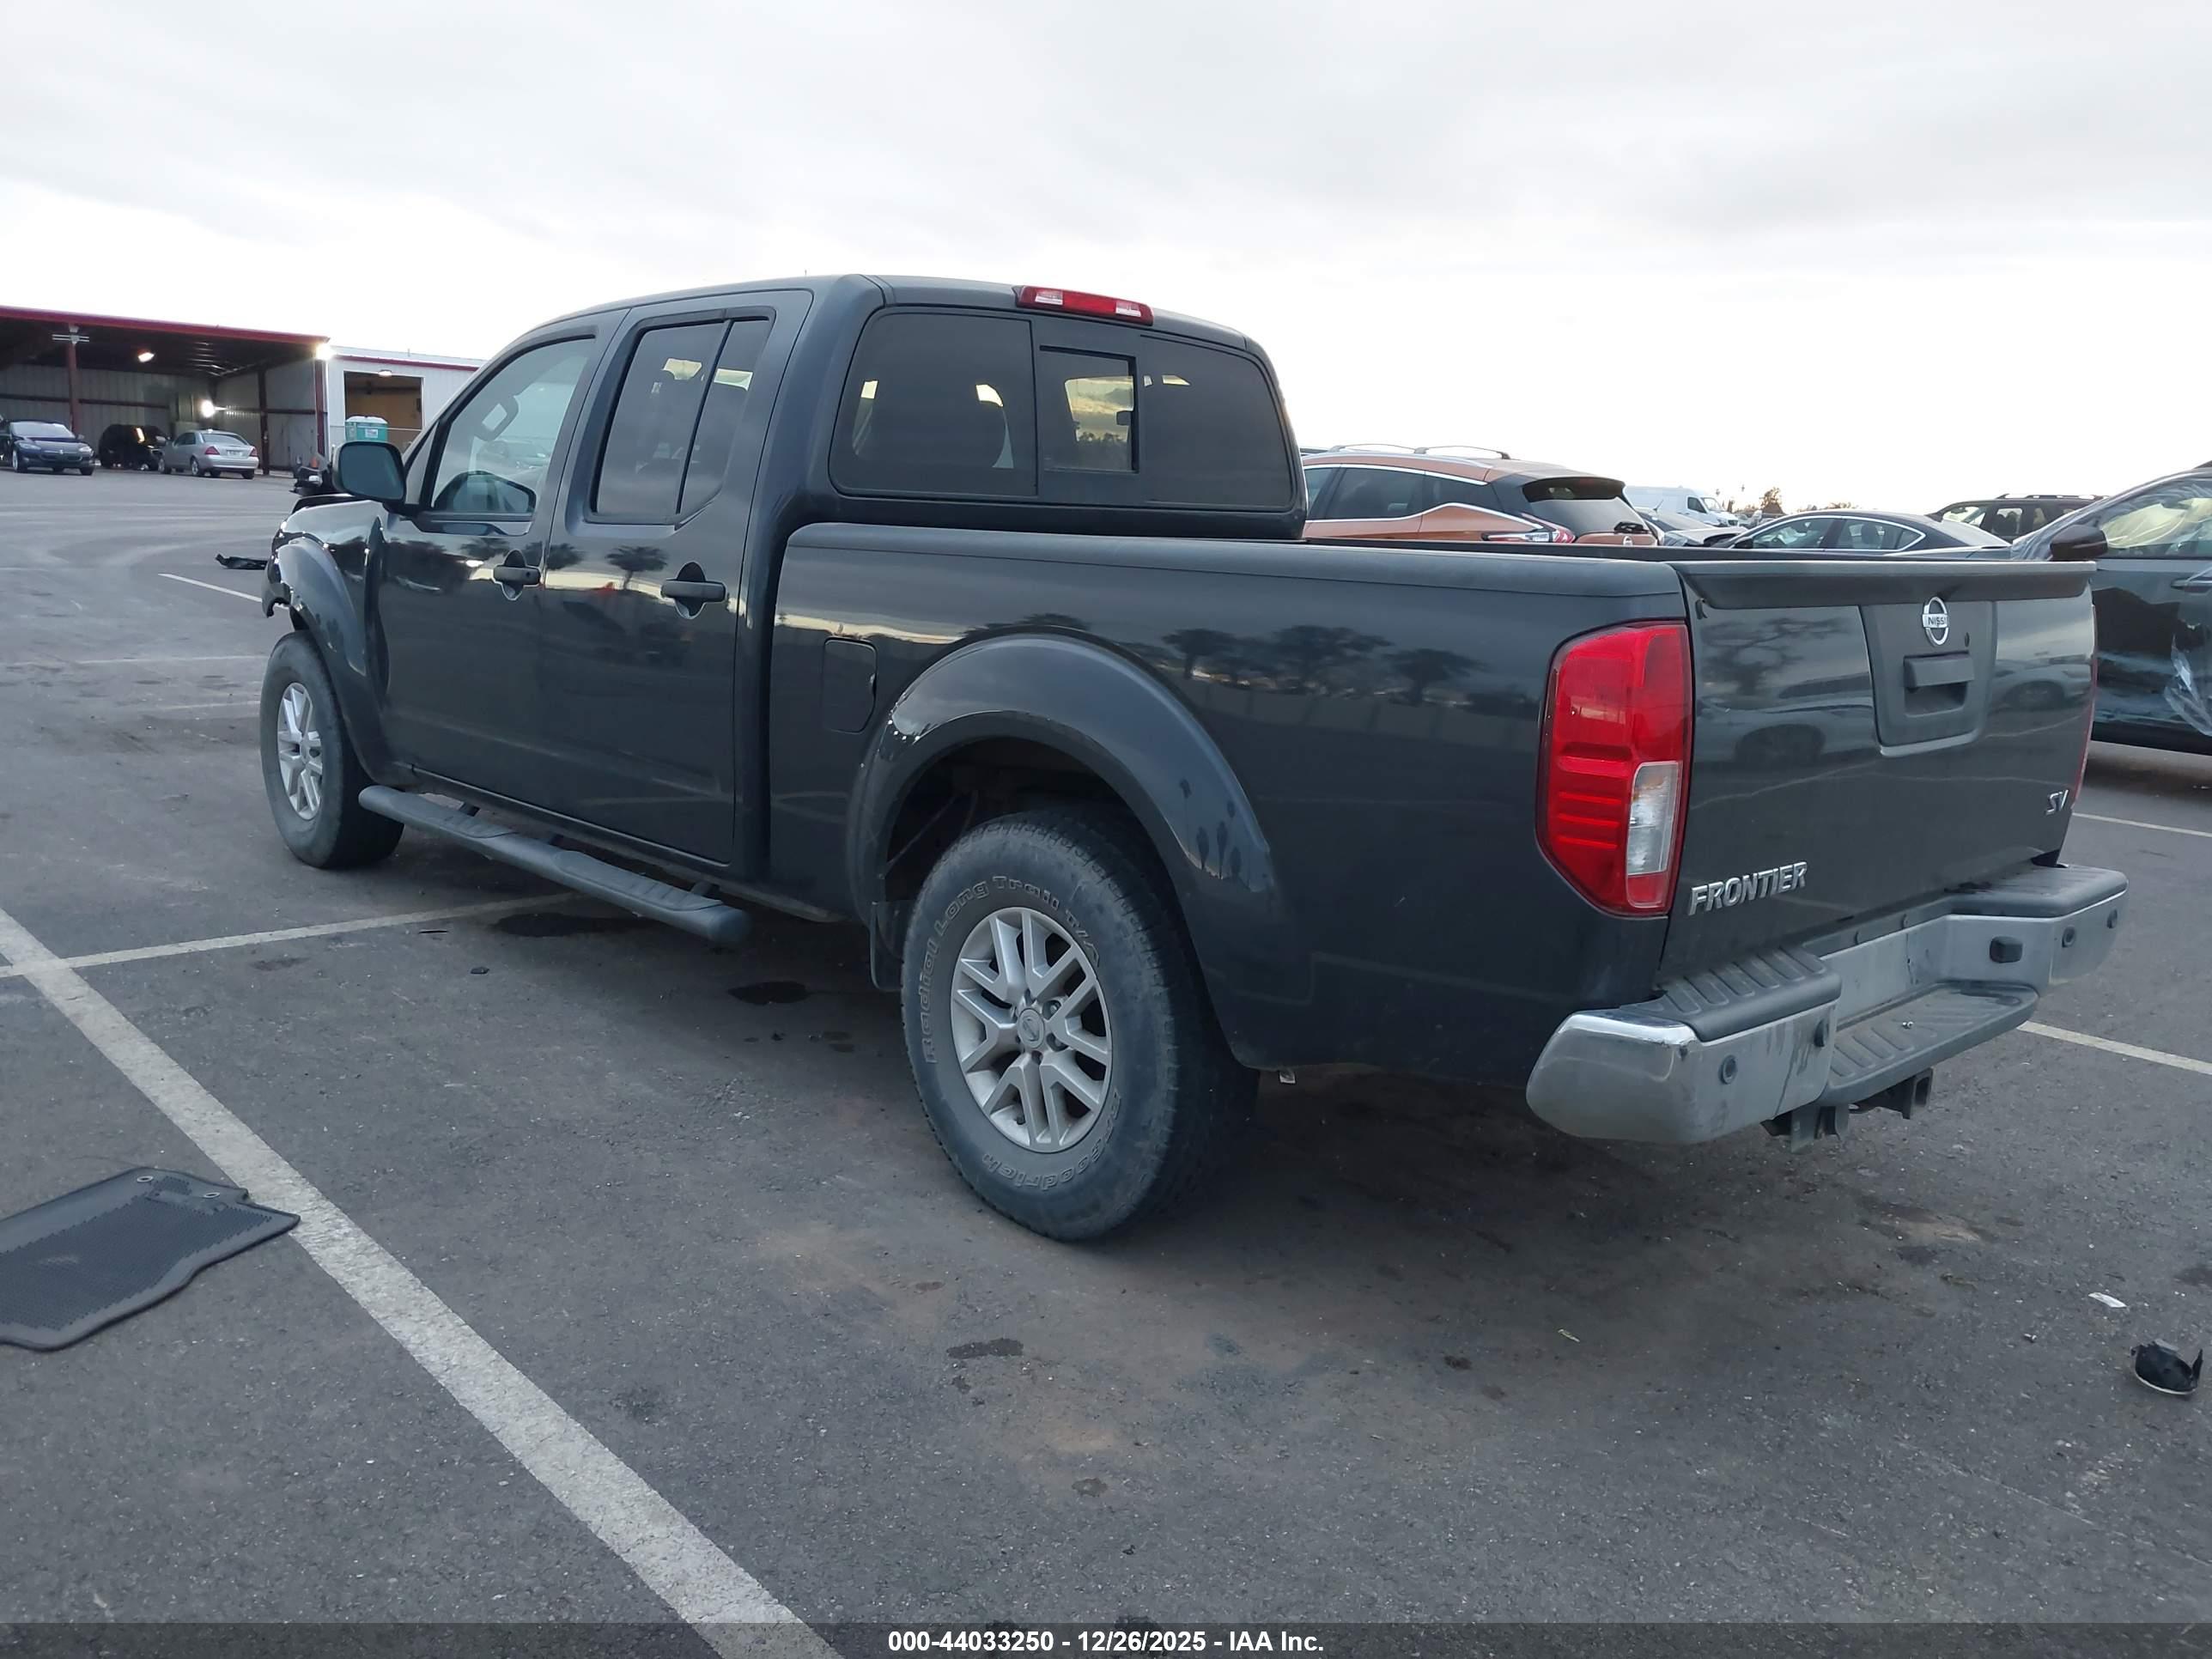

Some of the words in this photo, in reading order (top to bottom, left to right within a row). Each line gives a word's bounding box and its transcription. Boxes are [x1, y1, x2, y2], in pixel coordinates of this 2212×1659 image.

[2045, 789, 2069, 816] SV
[1688, 861, 1808, 916] FRONTIER
[918, 938, 939, 1065] Radial
[933, 880, 989, 937] Long
[992, 875, 1060, 911] Trail
